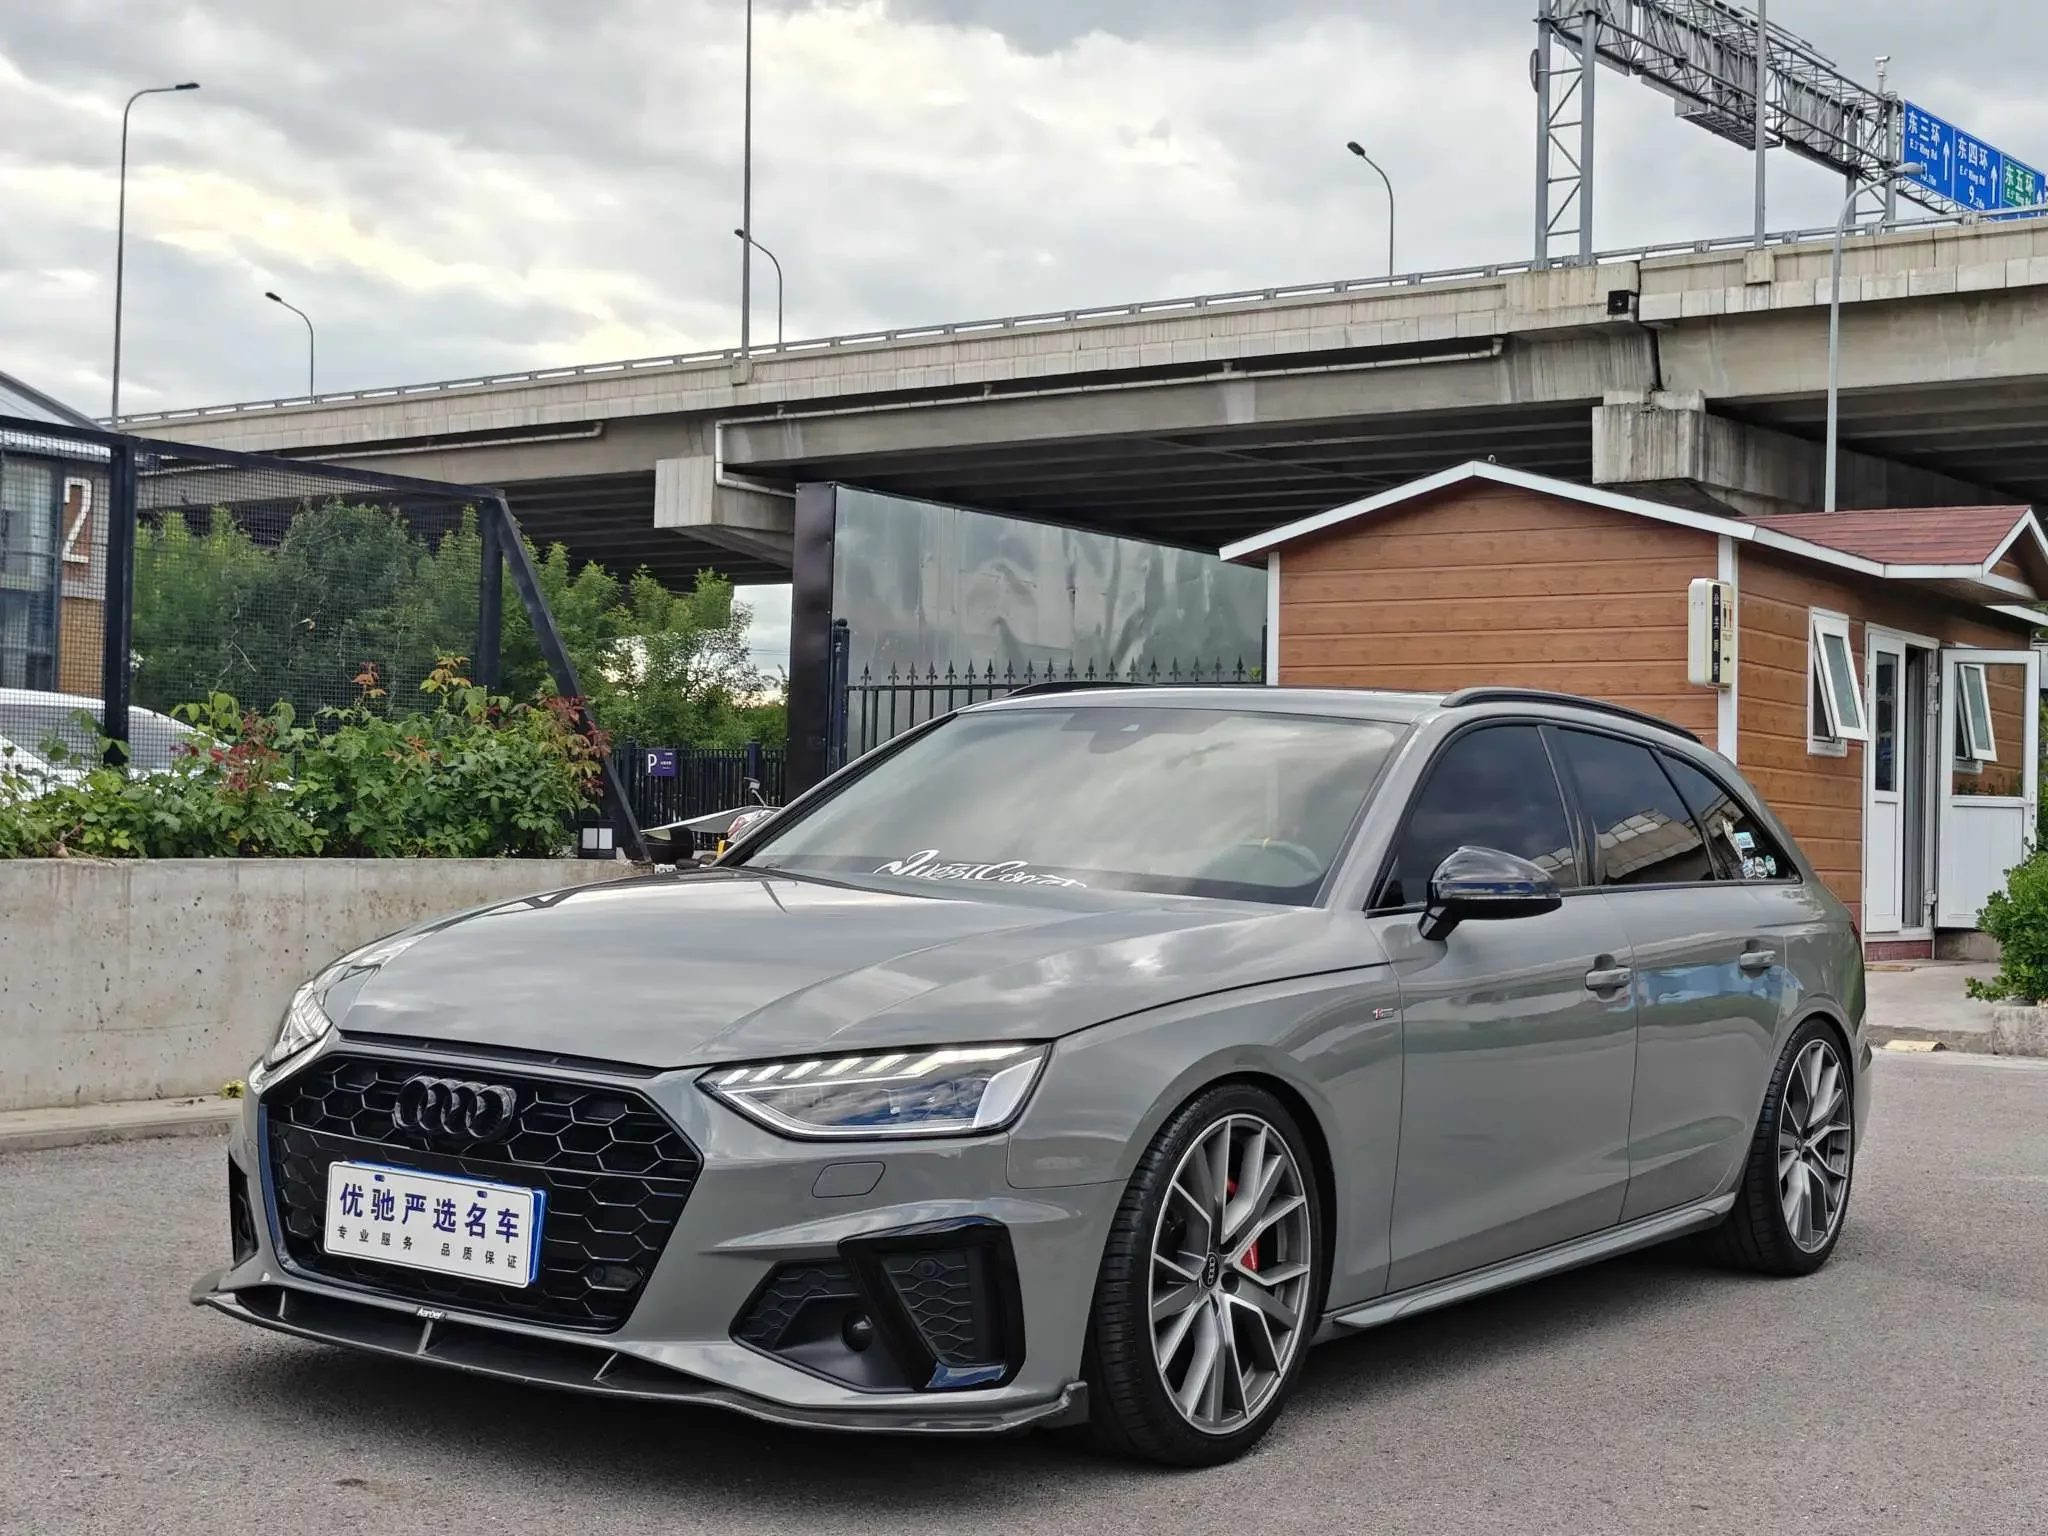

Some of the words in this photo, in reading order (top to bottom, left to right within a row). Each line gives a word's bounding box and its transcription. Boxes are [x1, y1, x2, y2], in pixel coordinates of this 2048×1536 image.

[1908, 110, 1940, 147] 东三环
[1958, 137, 1988, 170] 东四环
[2005, 164, 2034, 197] 东五环
[62, 476, 92, 564] 2
[647, 753, 658, 774] P
[339, 1182, 520, 1244] 优驰严选名车
[336, 1225, 413, 1251] 专业服务
[440, 1242, 517, 1269] 品质保证
